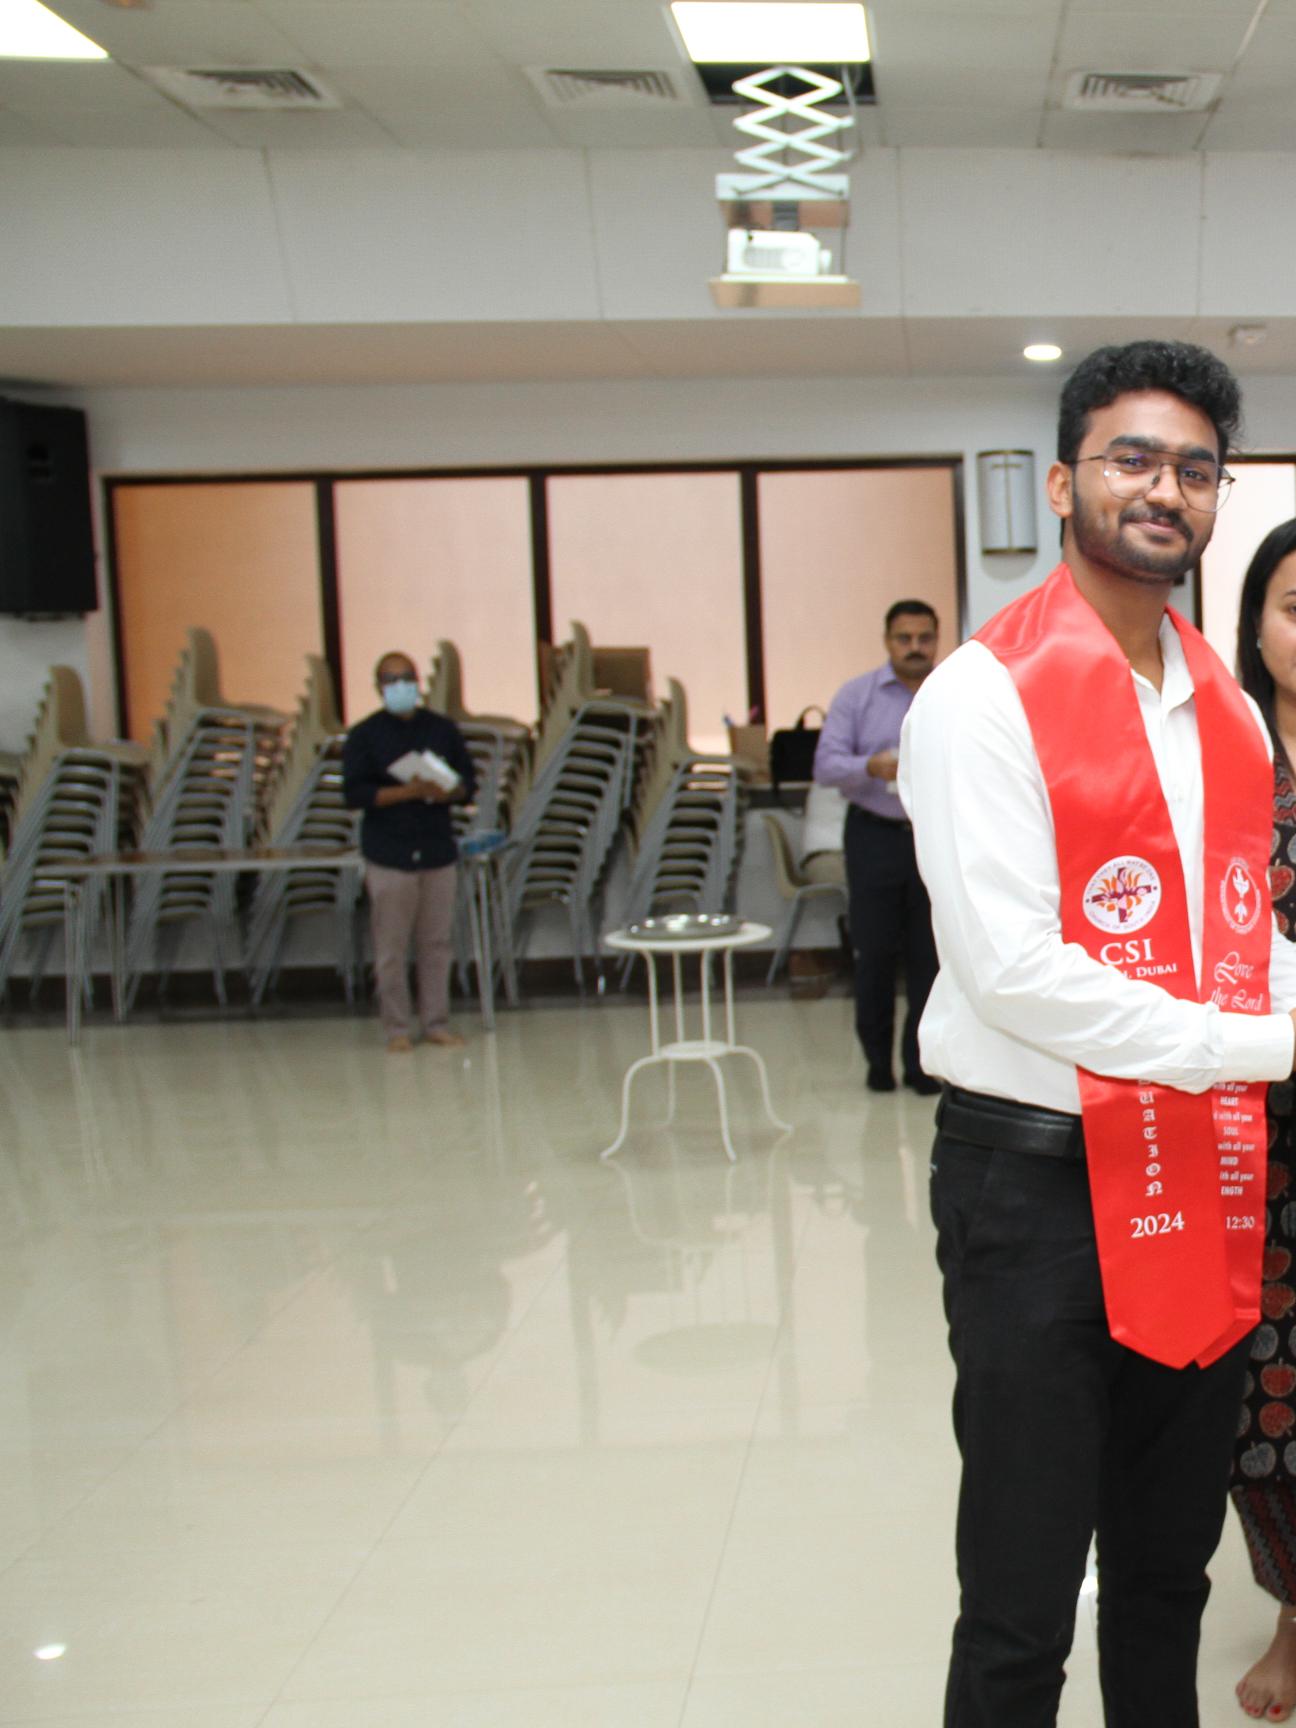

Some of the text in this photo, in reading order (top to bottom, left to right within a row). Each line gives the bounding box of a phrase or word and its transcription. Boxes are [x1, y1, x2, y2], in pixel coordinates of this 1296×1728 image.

[1100, 938, 1155, 966] CSI
[1136, 963, 1177, 978] DUBAI
[1214, 951, 1254, 985] Love
[1210, 986, 1263, 1012] the Lord
[1130, 1211, 1185, 1239] 2024
[1226, 1216, 1256, 1230] 12:30
